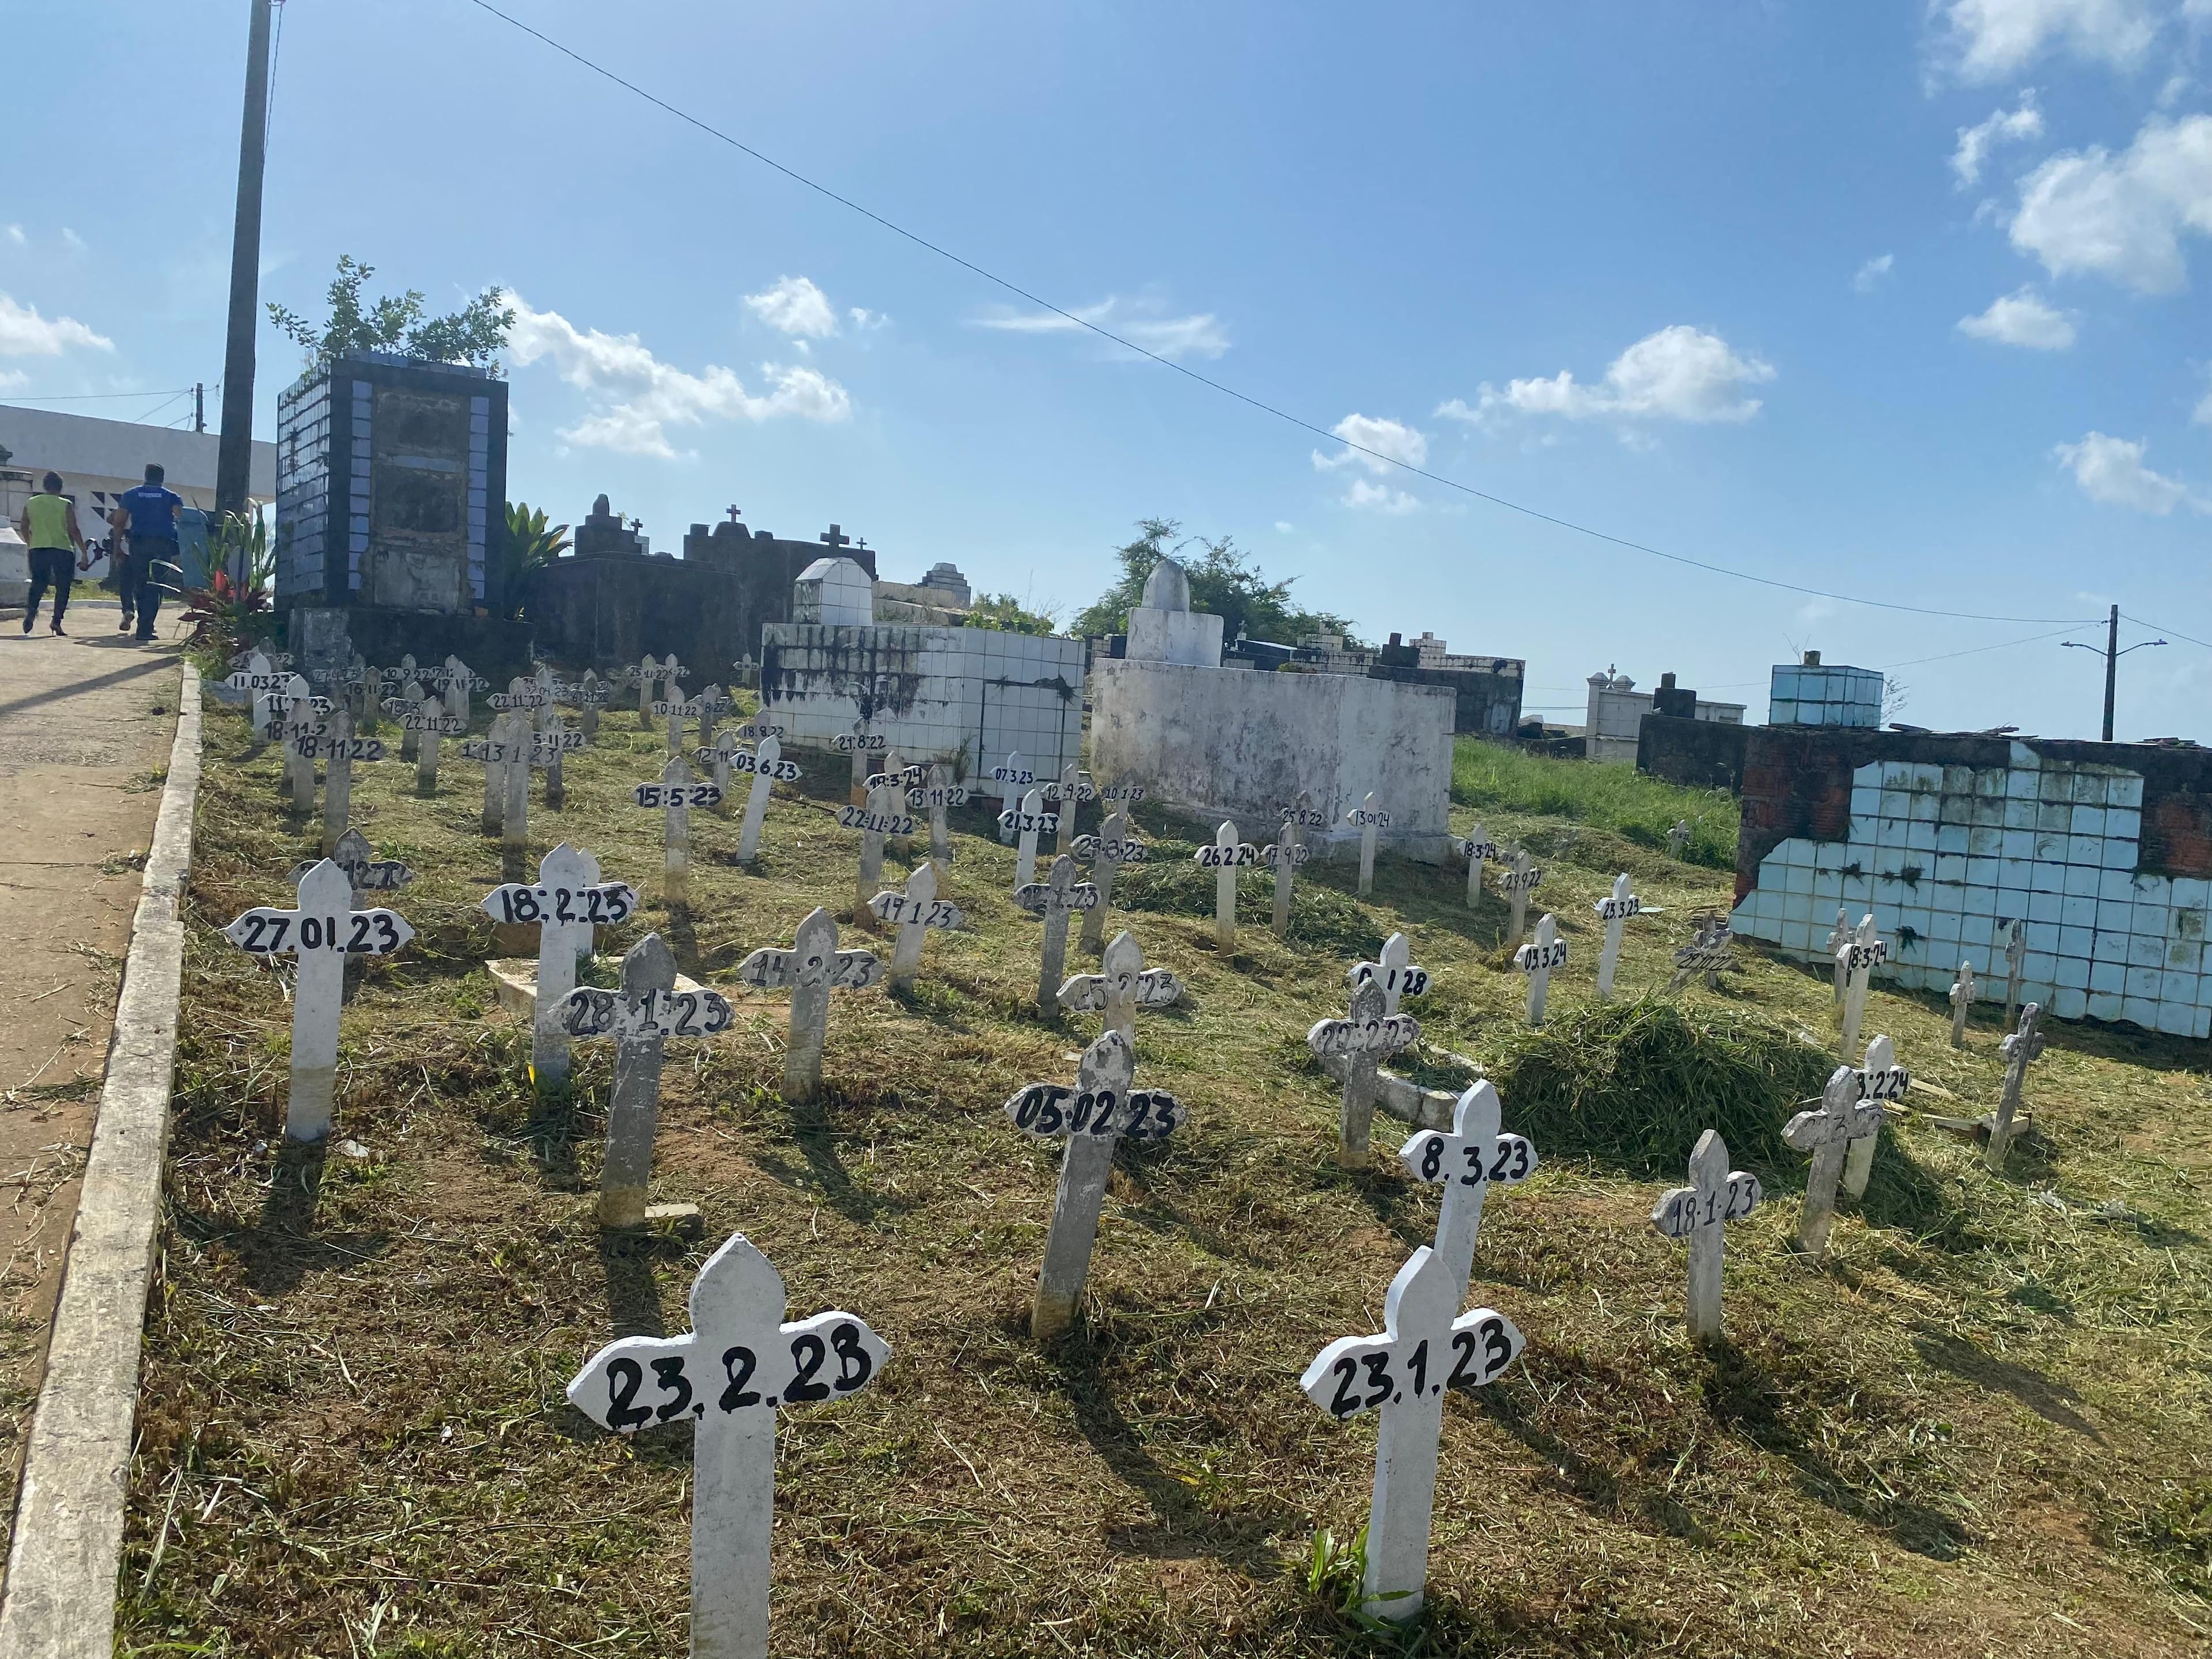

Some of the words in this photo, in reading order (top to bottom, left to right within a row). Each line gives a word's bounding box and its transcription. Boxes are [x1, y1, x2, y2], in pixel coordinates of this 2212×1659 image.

[736, 753, 797, 781] 03.6.23
[995, 768, 1033, 785] 07.3.23
[1004, 812, 1059, 833] 21.3.23
[1202, 847, 1255, 867] 26.2.24
[1525, 942, 1567, 971] 03.3.24
[1422, 1136, 1529, 1189] 8.3.23
[605, 1323, 872, 1431] 23.2.23
[1330, 1318, 1512, 1419] 23.1.23
